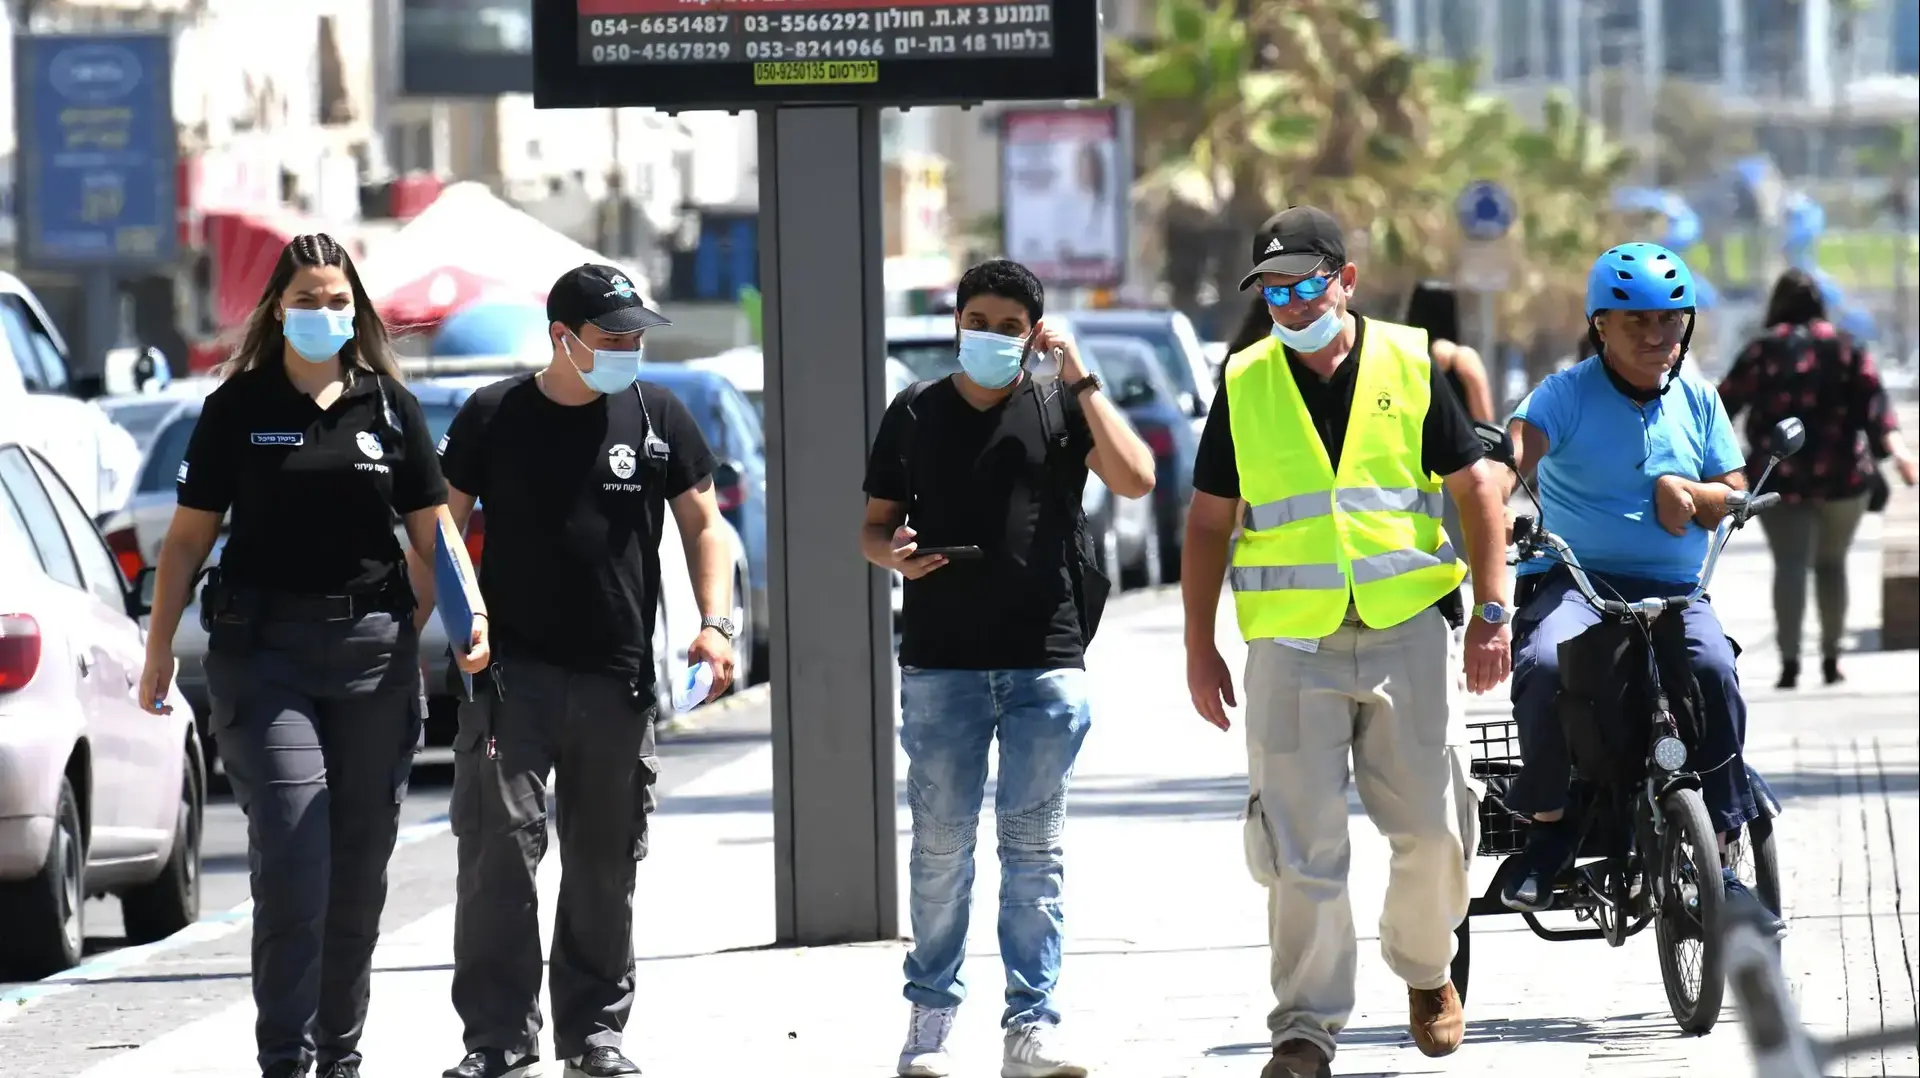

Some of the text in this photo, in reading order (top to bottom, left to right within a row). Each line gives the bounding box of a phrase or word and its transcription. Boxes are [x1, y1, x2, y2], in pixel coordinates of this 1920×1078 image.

[591, 4, 1050, 36] תמנע 3 א.ת. חולון 03-5566292 054-6651487
[592, 28, 1051, 62] בלפור 18 בת-ים 053-8211966 050-4567829
[756, 60, 876, 81] לפירסום 050-9250135
[354, 462, 374, 472] עירוני
[602, 483, 642, 493] פיקוח עירוני
